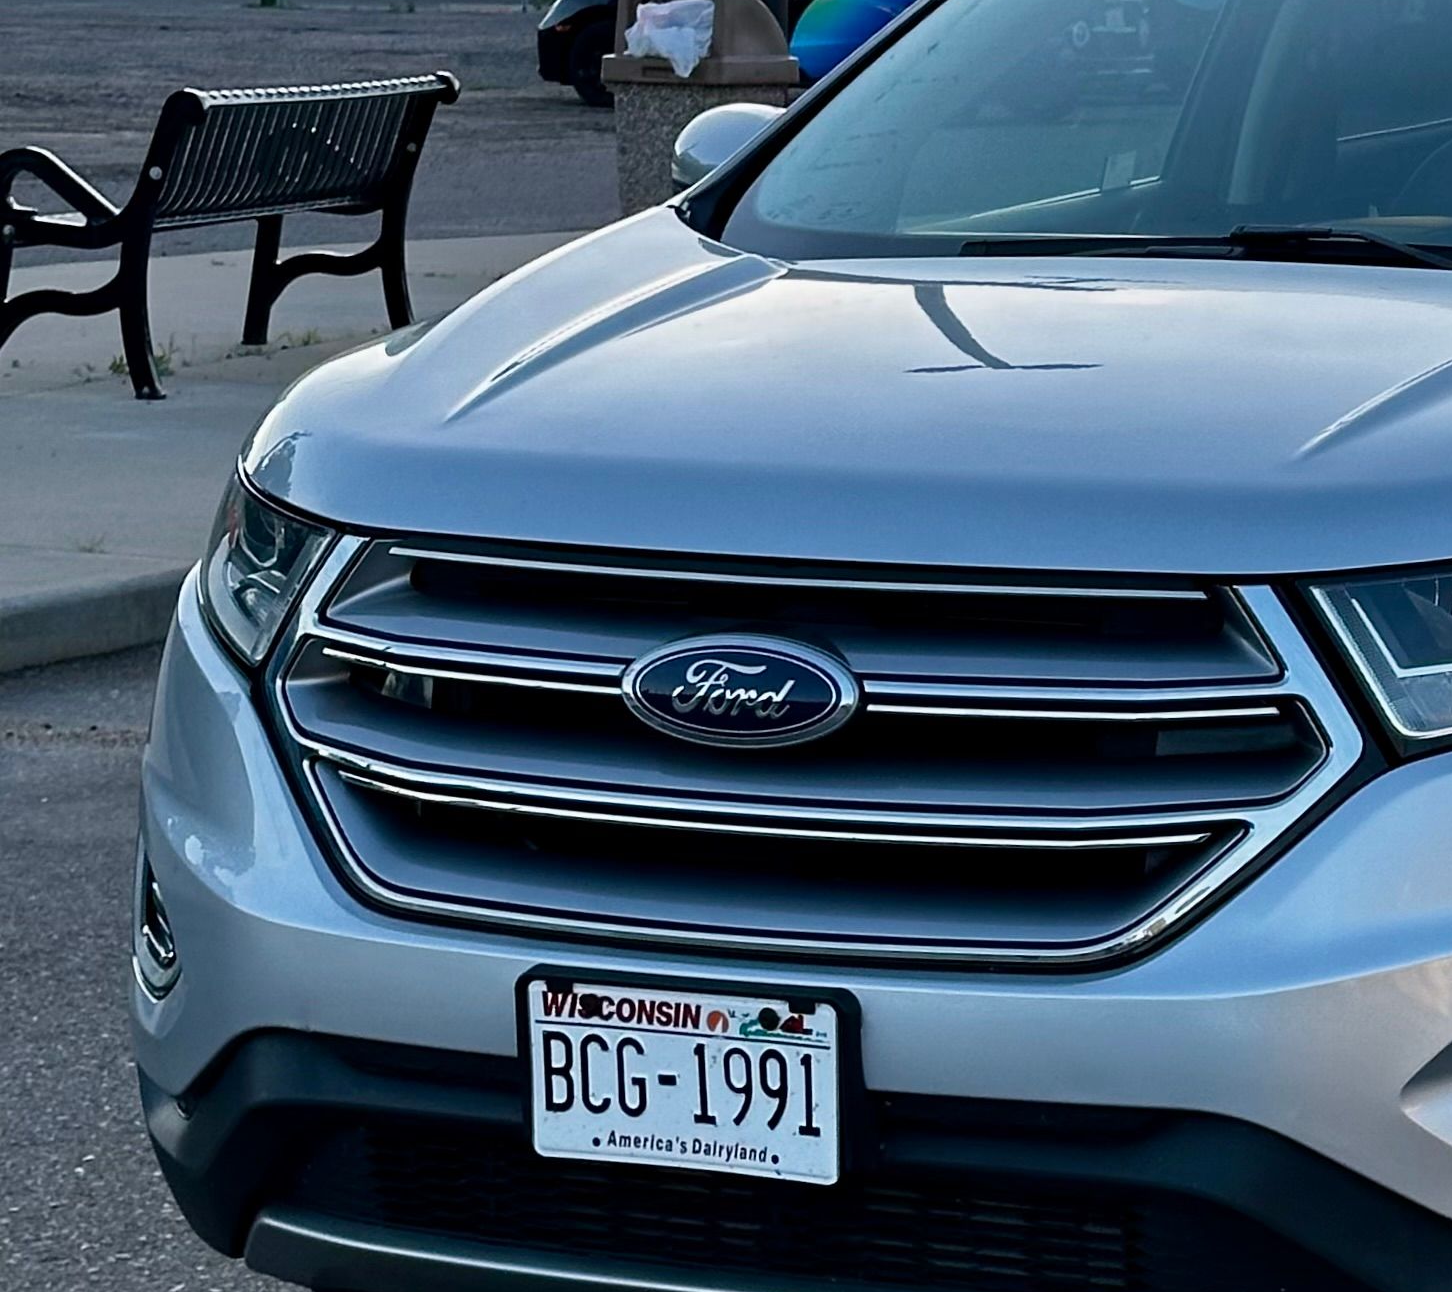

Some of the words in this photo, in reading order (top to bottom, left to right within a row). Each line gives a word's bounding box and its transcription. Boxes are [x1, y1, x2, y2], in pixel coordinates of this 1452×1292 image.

[672, 659, 796, 719] Ford
[542, 1030, 821, 1137] BCG-1991
[607, 1130, 688, 1154] America's
[692, 1138, 768, 1162] Dairyland
